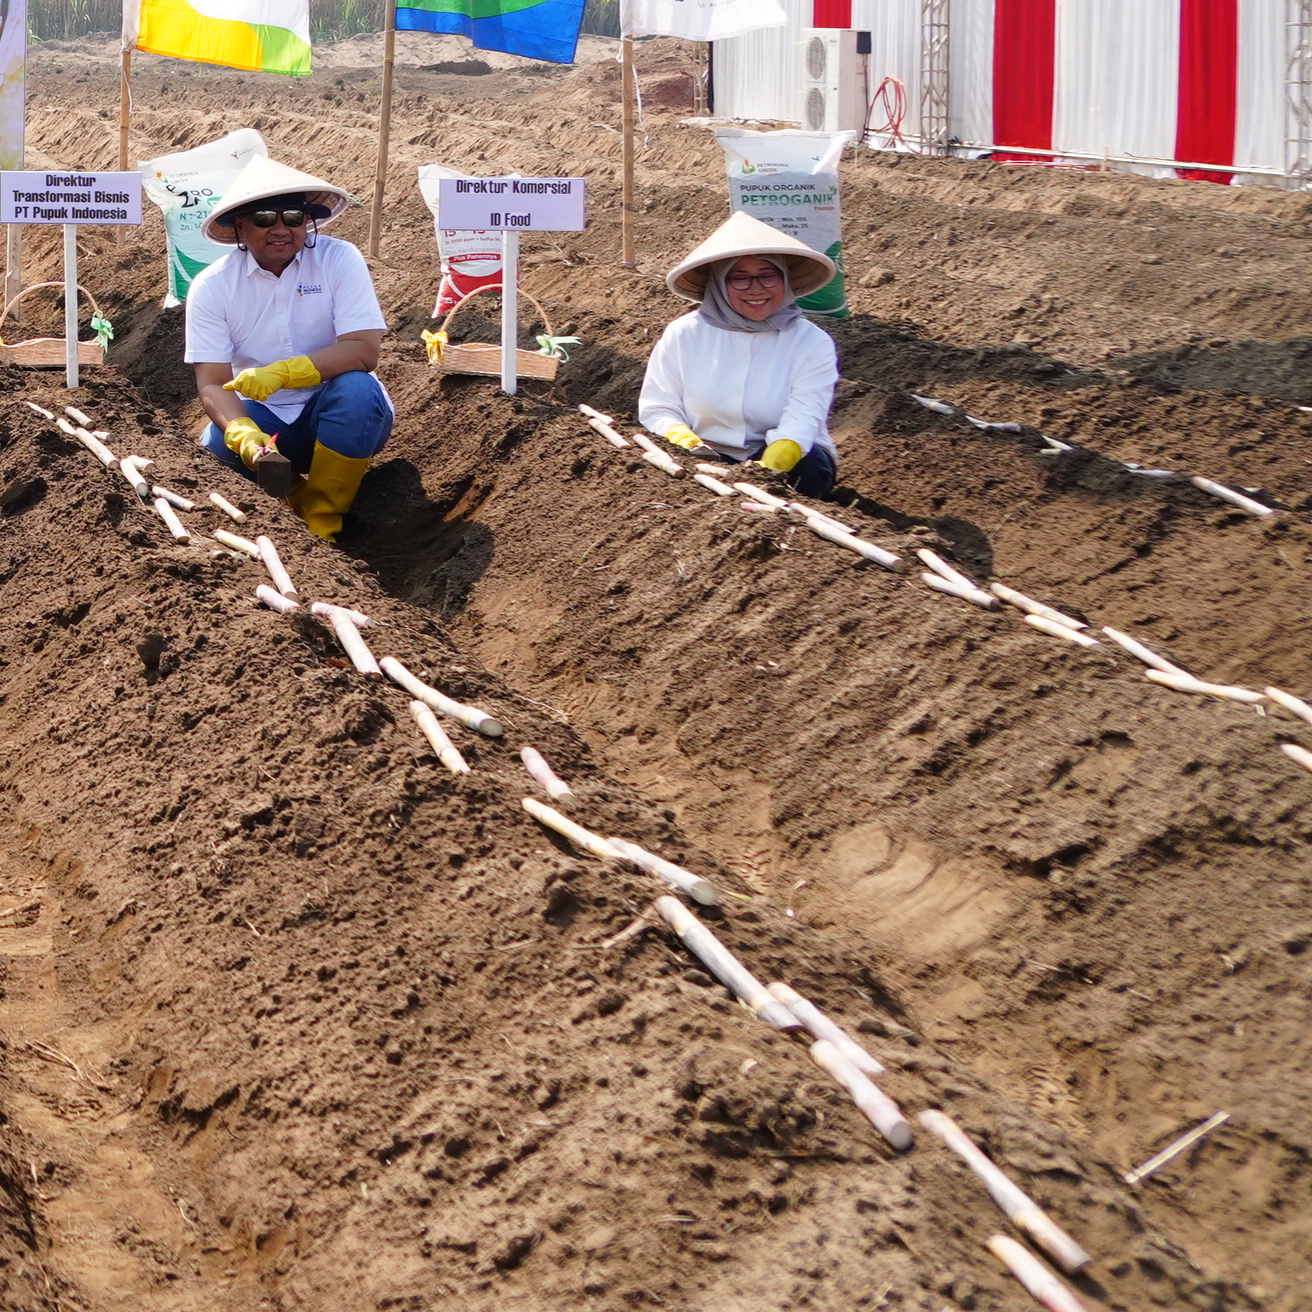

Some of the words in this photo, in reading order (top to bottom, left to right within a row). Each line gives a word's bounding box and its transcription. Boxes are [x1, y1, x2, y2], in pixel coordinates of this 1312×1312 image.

[46, 174, 96, 187] Direktur
[456, 179, 508, 194] Direktur
[512, 180, 571, 194] Komersial
[12, 190, 91, 203] Transformasi
[94, 191, 130, 204] Bisnis
[741, 194, 834, 206] PETROGANIK
[14, 206, 28, 218] PT
[32, 207, 68, 220] Pupuk
[72, 207, 127, 219] Indonesia
[490, 212, 501, 226] ID
[504, 213, 531, 227] Food
